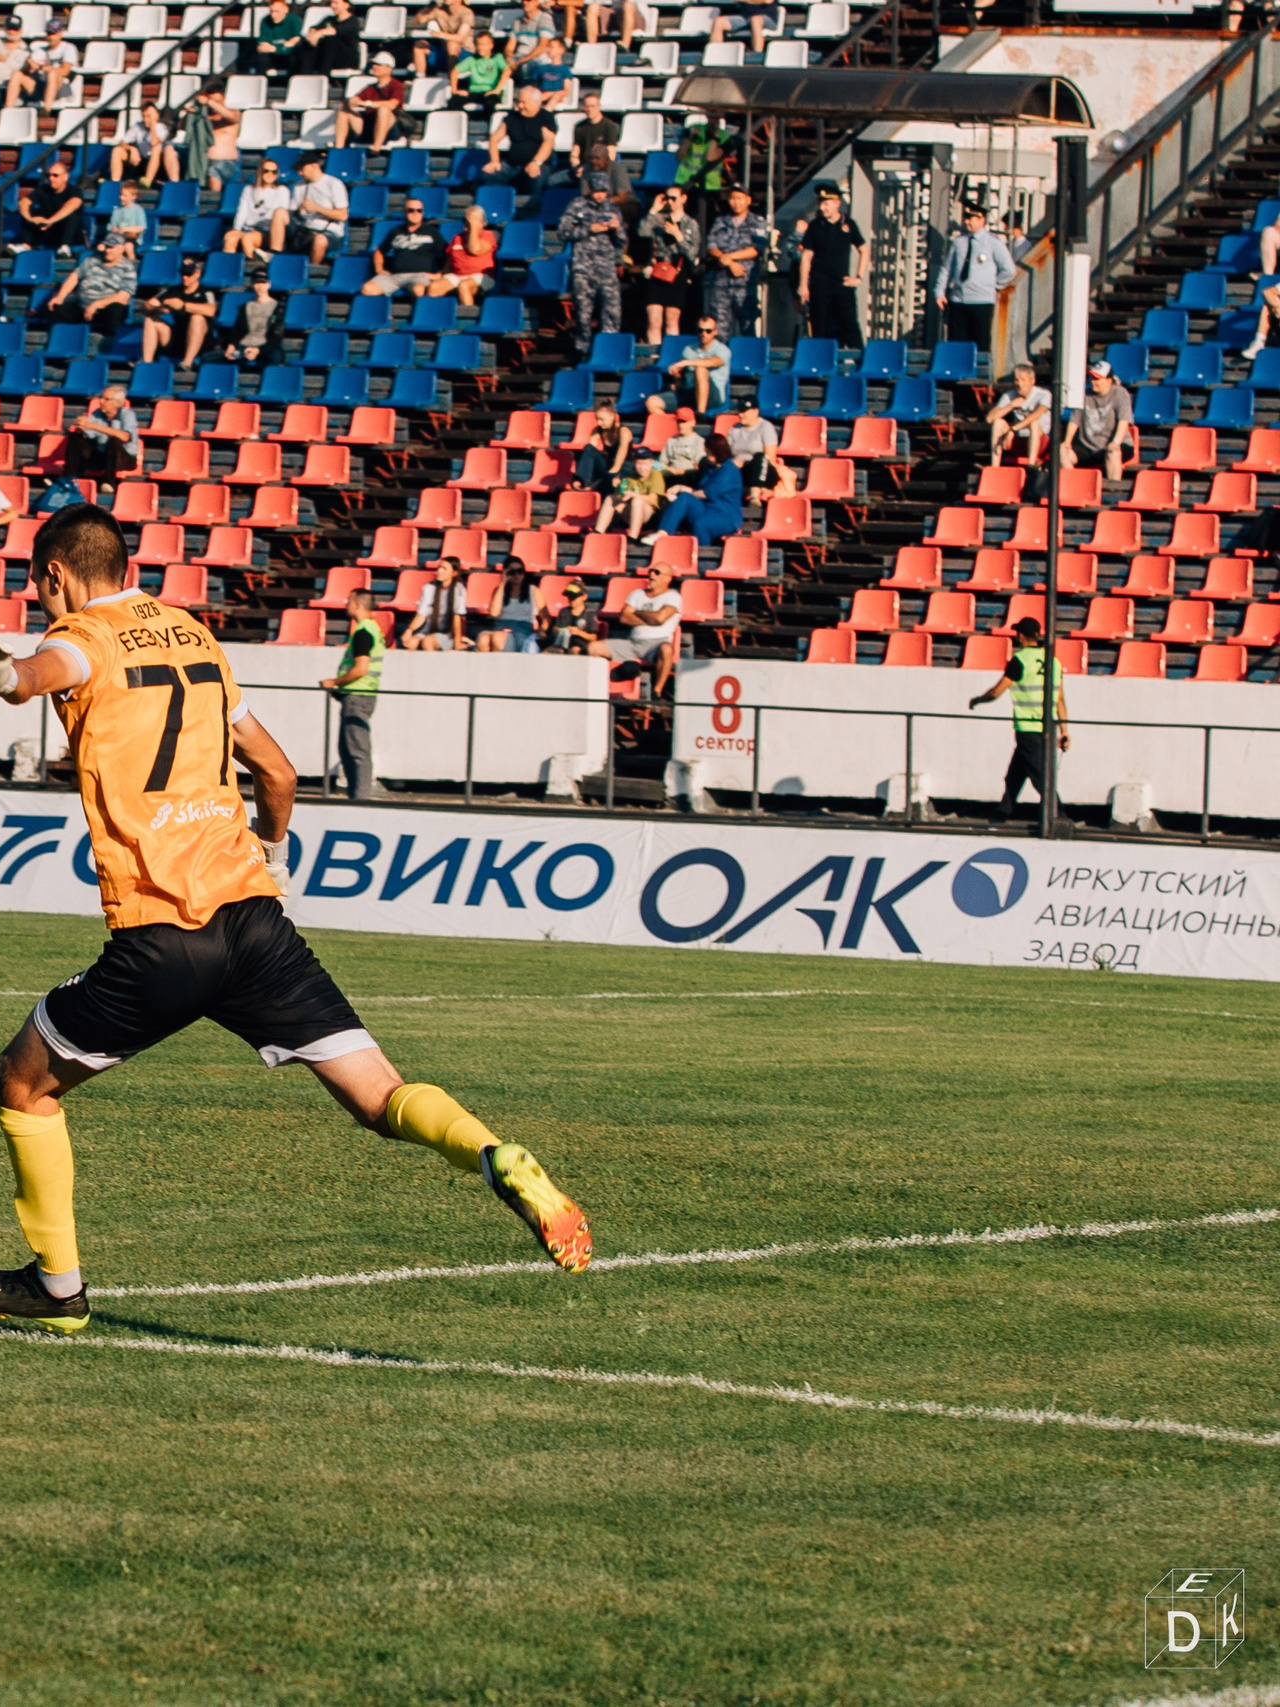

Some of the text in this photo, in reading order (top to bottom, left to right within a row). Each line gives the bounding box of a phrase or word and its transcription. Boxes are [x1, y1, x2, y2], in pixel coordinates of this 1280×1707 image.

[132, 602, 161, 619] 1926
[125, 662, 228, 792] 77
[712, 675, 741, 734] 8
[639, 847, 951, 954] ОАК
[1046, 866, 1248, 898] ИРКУТСКИЙ
[1023, 939, 1141, 970] ЗАВОД
